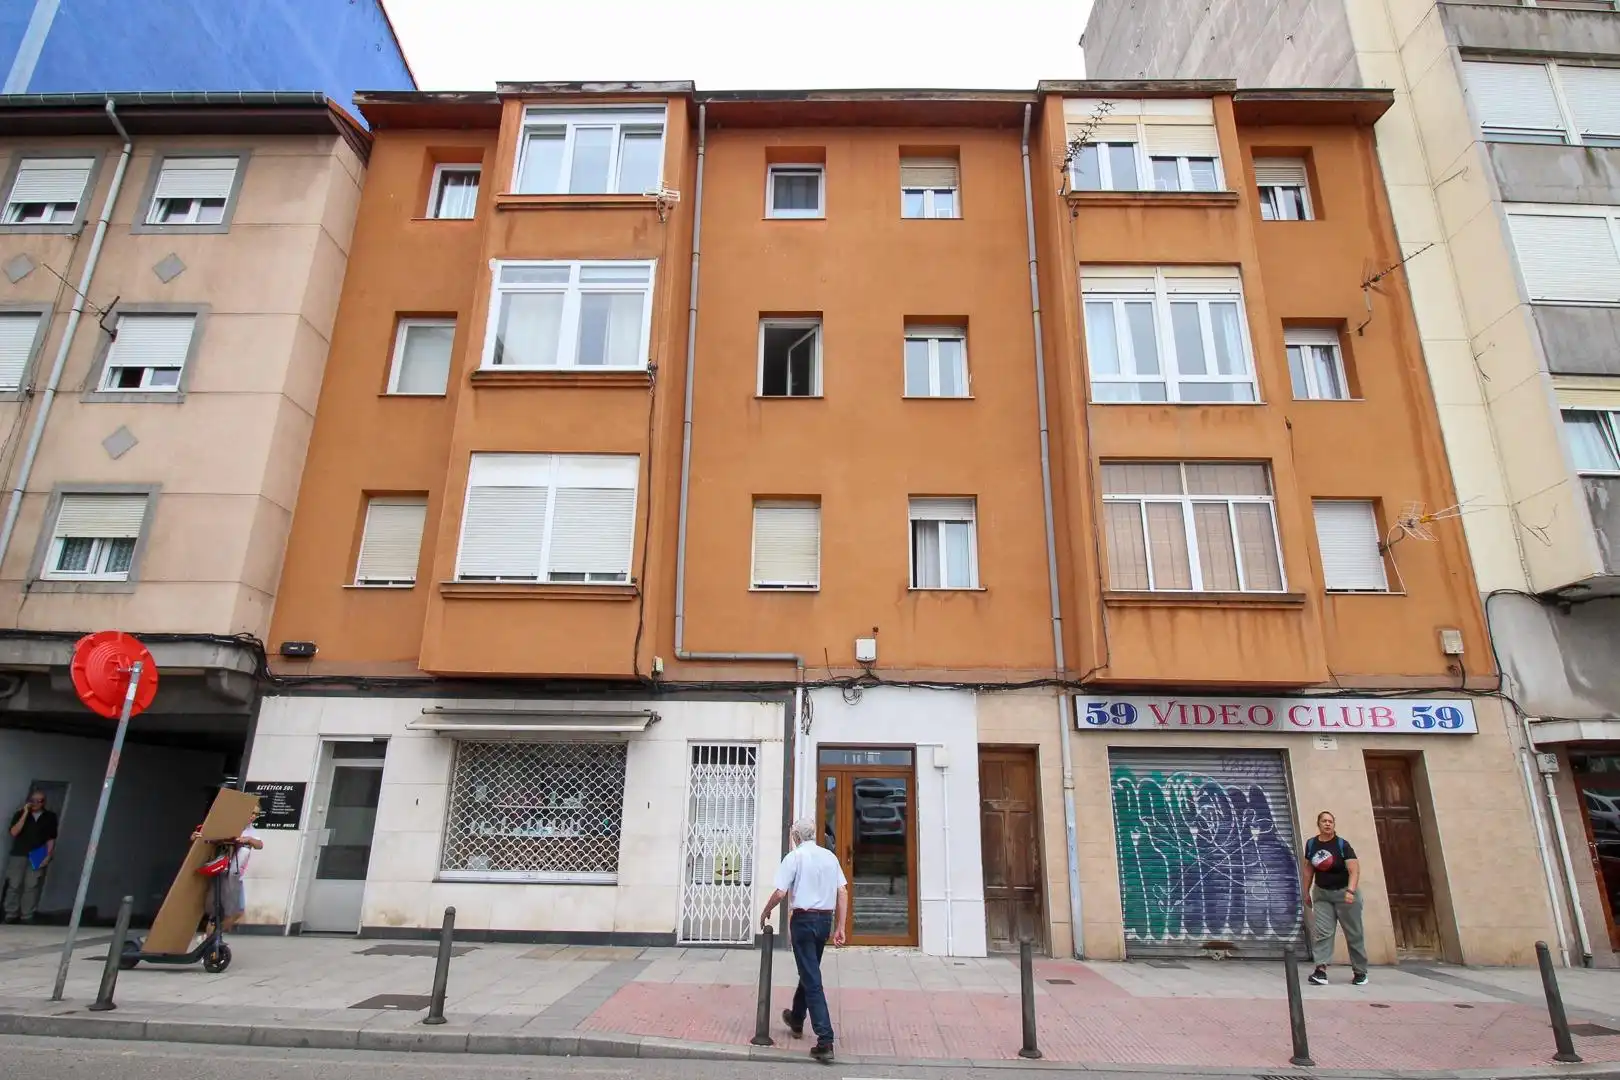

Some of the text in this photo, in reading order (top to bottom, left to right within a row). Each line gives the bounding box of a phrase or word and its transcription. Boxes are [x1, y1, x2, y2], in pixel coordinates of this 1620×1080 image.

[1086, 701, 1464, 729] 59 VIDEO CLUB 59
